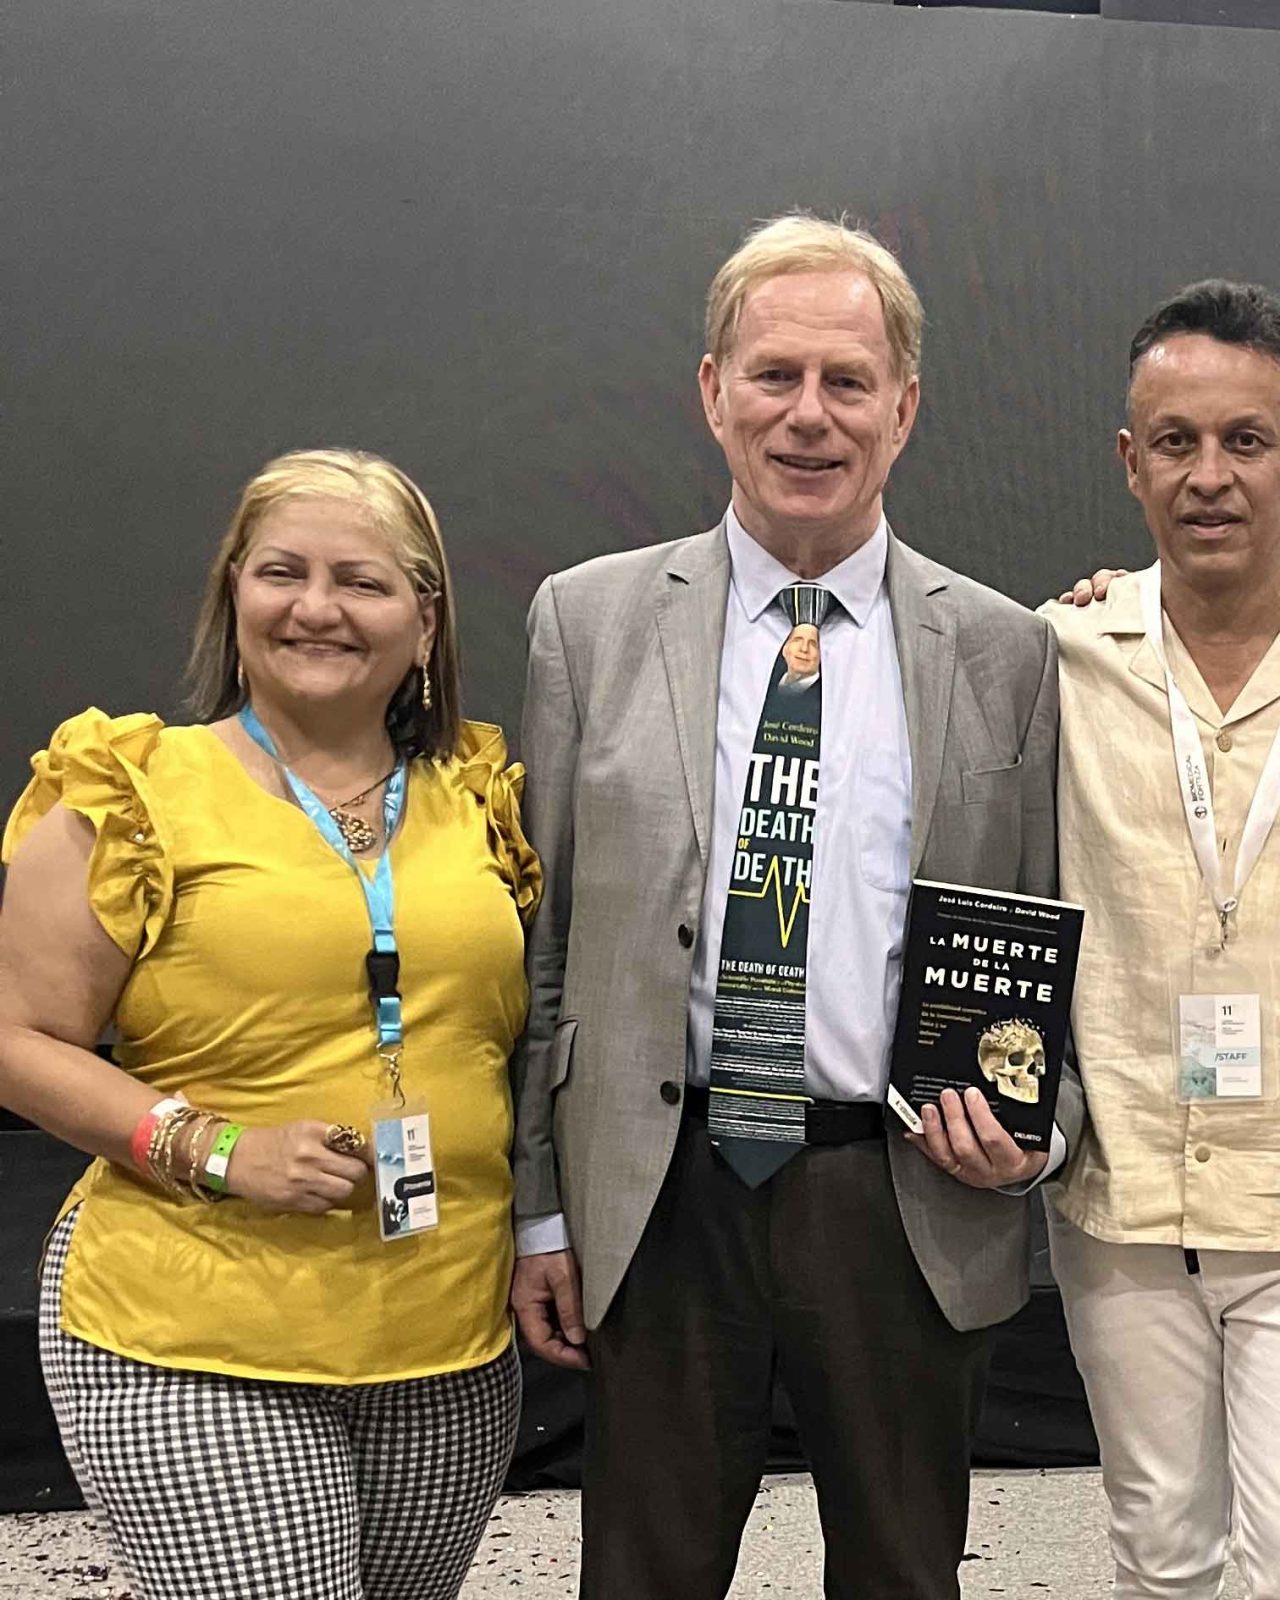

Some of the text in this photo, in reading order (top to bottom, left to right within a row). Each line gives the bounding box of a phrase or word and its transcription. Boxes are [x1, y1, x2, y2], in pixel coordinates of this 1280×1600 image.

[751, 753, 819, 810] THE
[740, 807, 816, 844] DEATH
[738, 838, 750, 850] OF
[734, 851, 812, 888] DEATH
[957, 898, 973, 907] Luis
[974, 900, 1008, 912] Cordeiro
[1015, 907, 1037, 917] David
[1038, 910, 1060, 920] Wood
[929, 933, 1059, 964] LA MUERTE
[721, 960, 805, 978] THE DEATH OF DEATH
[972, 958, 1010, 971] DE LA
[924, 966, 1053, 1003] MUERTE
